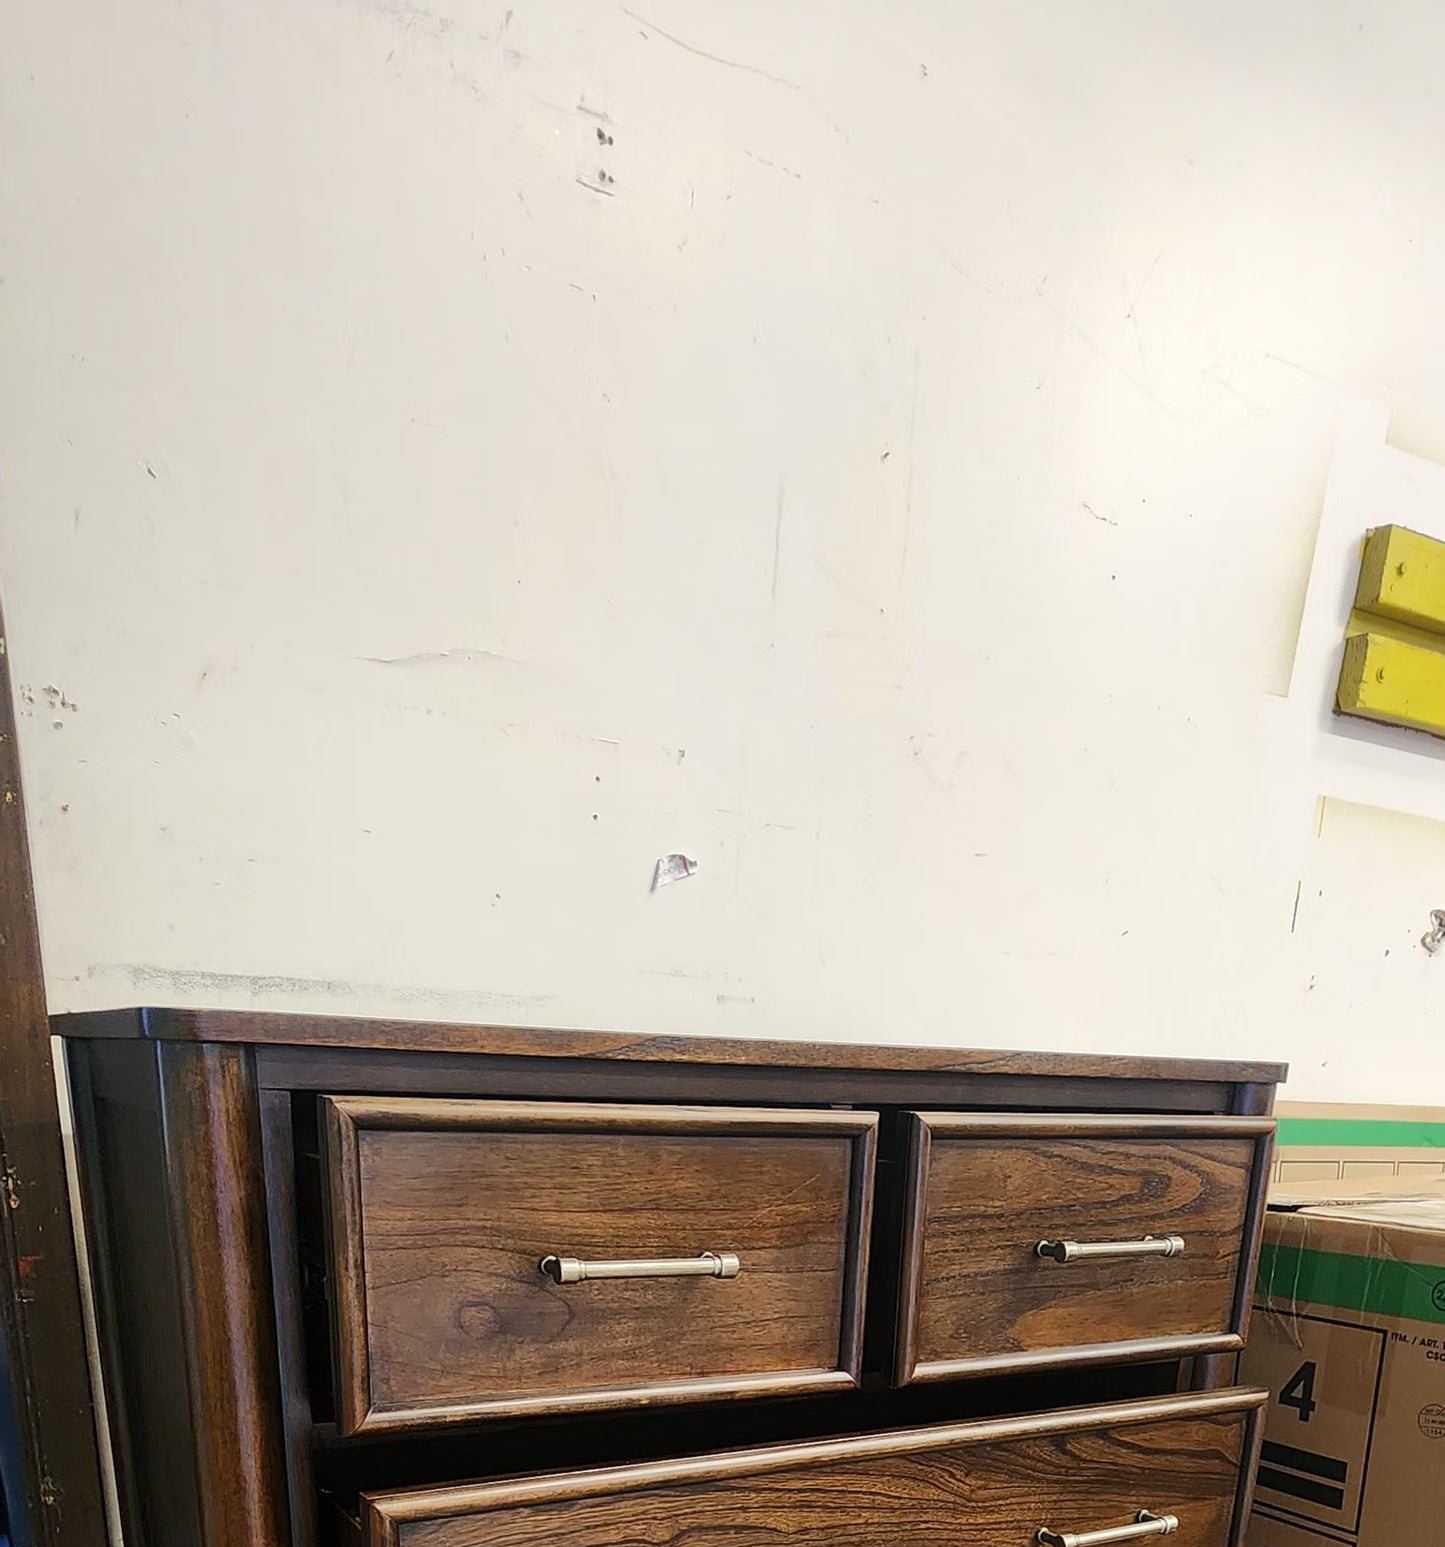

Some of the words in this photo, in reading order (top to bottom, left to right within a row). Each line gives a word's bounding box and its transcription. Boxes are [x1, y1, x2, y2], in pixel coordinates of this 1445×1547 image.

[1391, 1331, 1409, 1343] ITM.
[1411, 1336, 1417, 1346] /
[1419, 1338, 1439, 1349] ART.
[1279, 1361, 1316, 1422] 4
